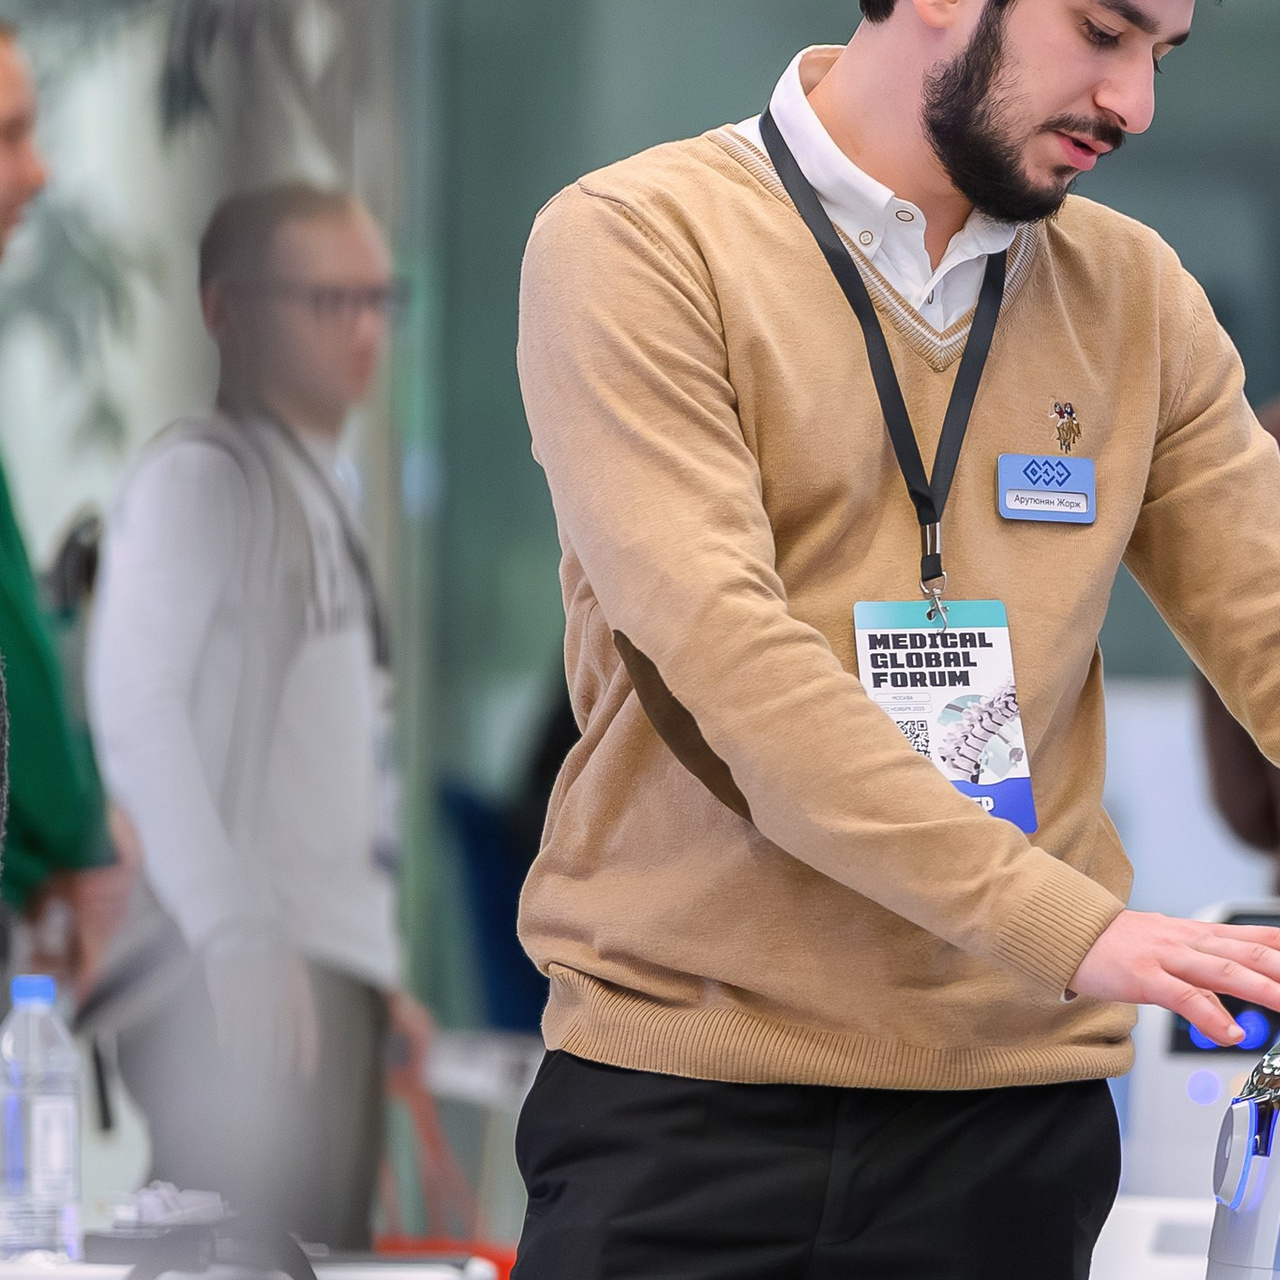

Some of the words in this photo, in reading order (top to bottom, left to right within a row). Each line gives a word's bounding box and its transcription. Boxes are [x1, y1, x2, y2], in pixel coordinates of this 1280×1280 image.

[1014, 494, 1055, 506] Арутюнян
[1057, 498, 1081, 510] Жорж
[868, 632, 993, 650] MEDICAL
[870, 651, 977, 669] GLOBAL
[872, 670, 970, 688] FORUM
